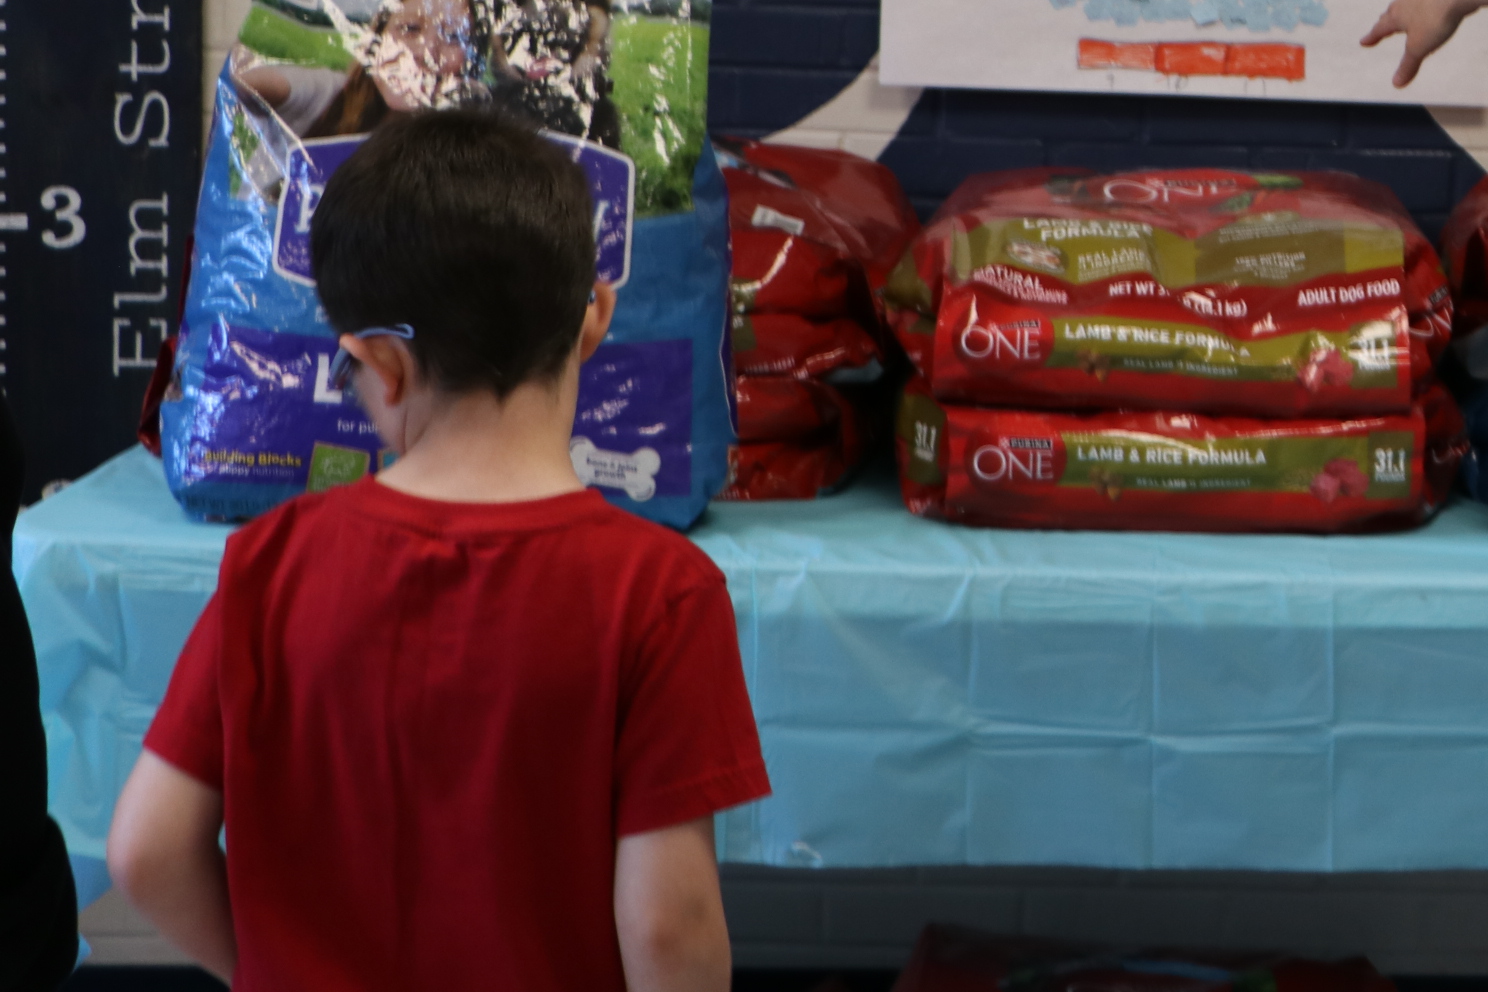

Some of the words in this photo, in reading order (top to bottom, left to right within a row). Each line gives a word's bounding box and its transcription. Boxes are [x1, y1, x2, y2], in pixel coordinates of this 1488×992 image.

[40, 185, 86, 248] 3
[1041, 225, 1141, 242] FORMULA
[113, 192, 169, 377] Elm
[974, 264, 1043, 290] NATURAL
[1109, 283, 1133, 297] NET
[1135, 281, 1157, 296] WT
[1298, 286, 1337, 307] ADULT
[1339, 283, 1365, 304] DOG
[1366, 278, 1401, 298] FOOD
[960, 325, 1042, 360] ONE
[1064, 322, 1112, 340] LAMB
[1132, 326, 1171, 344] RICE
[337, 417, 355, 432] for
[1010, 437, 1052, 450] PURINA
[204, 449, 256, 467] Building
[258, 452, 302, 469] Blocks
[973, 444, 1054, 481] ONE
[1077, 445, 1124, 463] LAMB
[1129, 447, 1142, 464] &
[1146, 447, 1183, 466] RICE
[1188, 447, 1267, 467] FORMULA
[1375, 447, 1407, 473] 31.1
